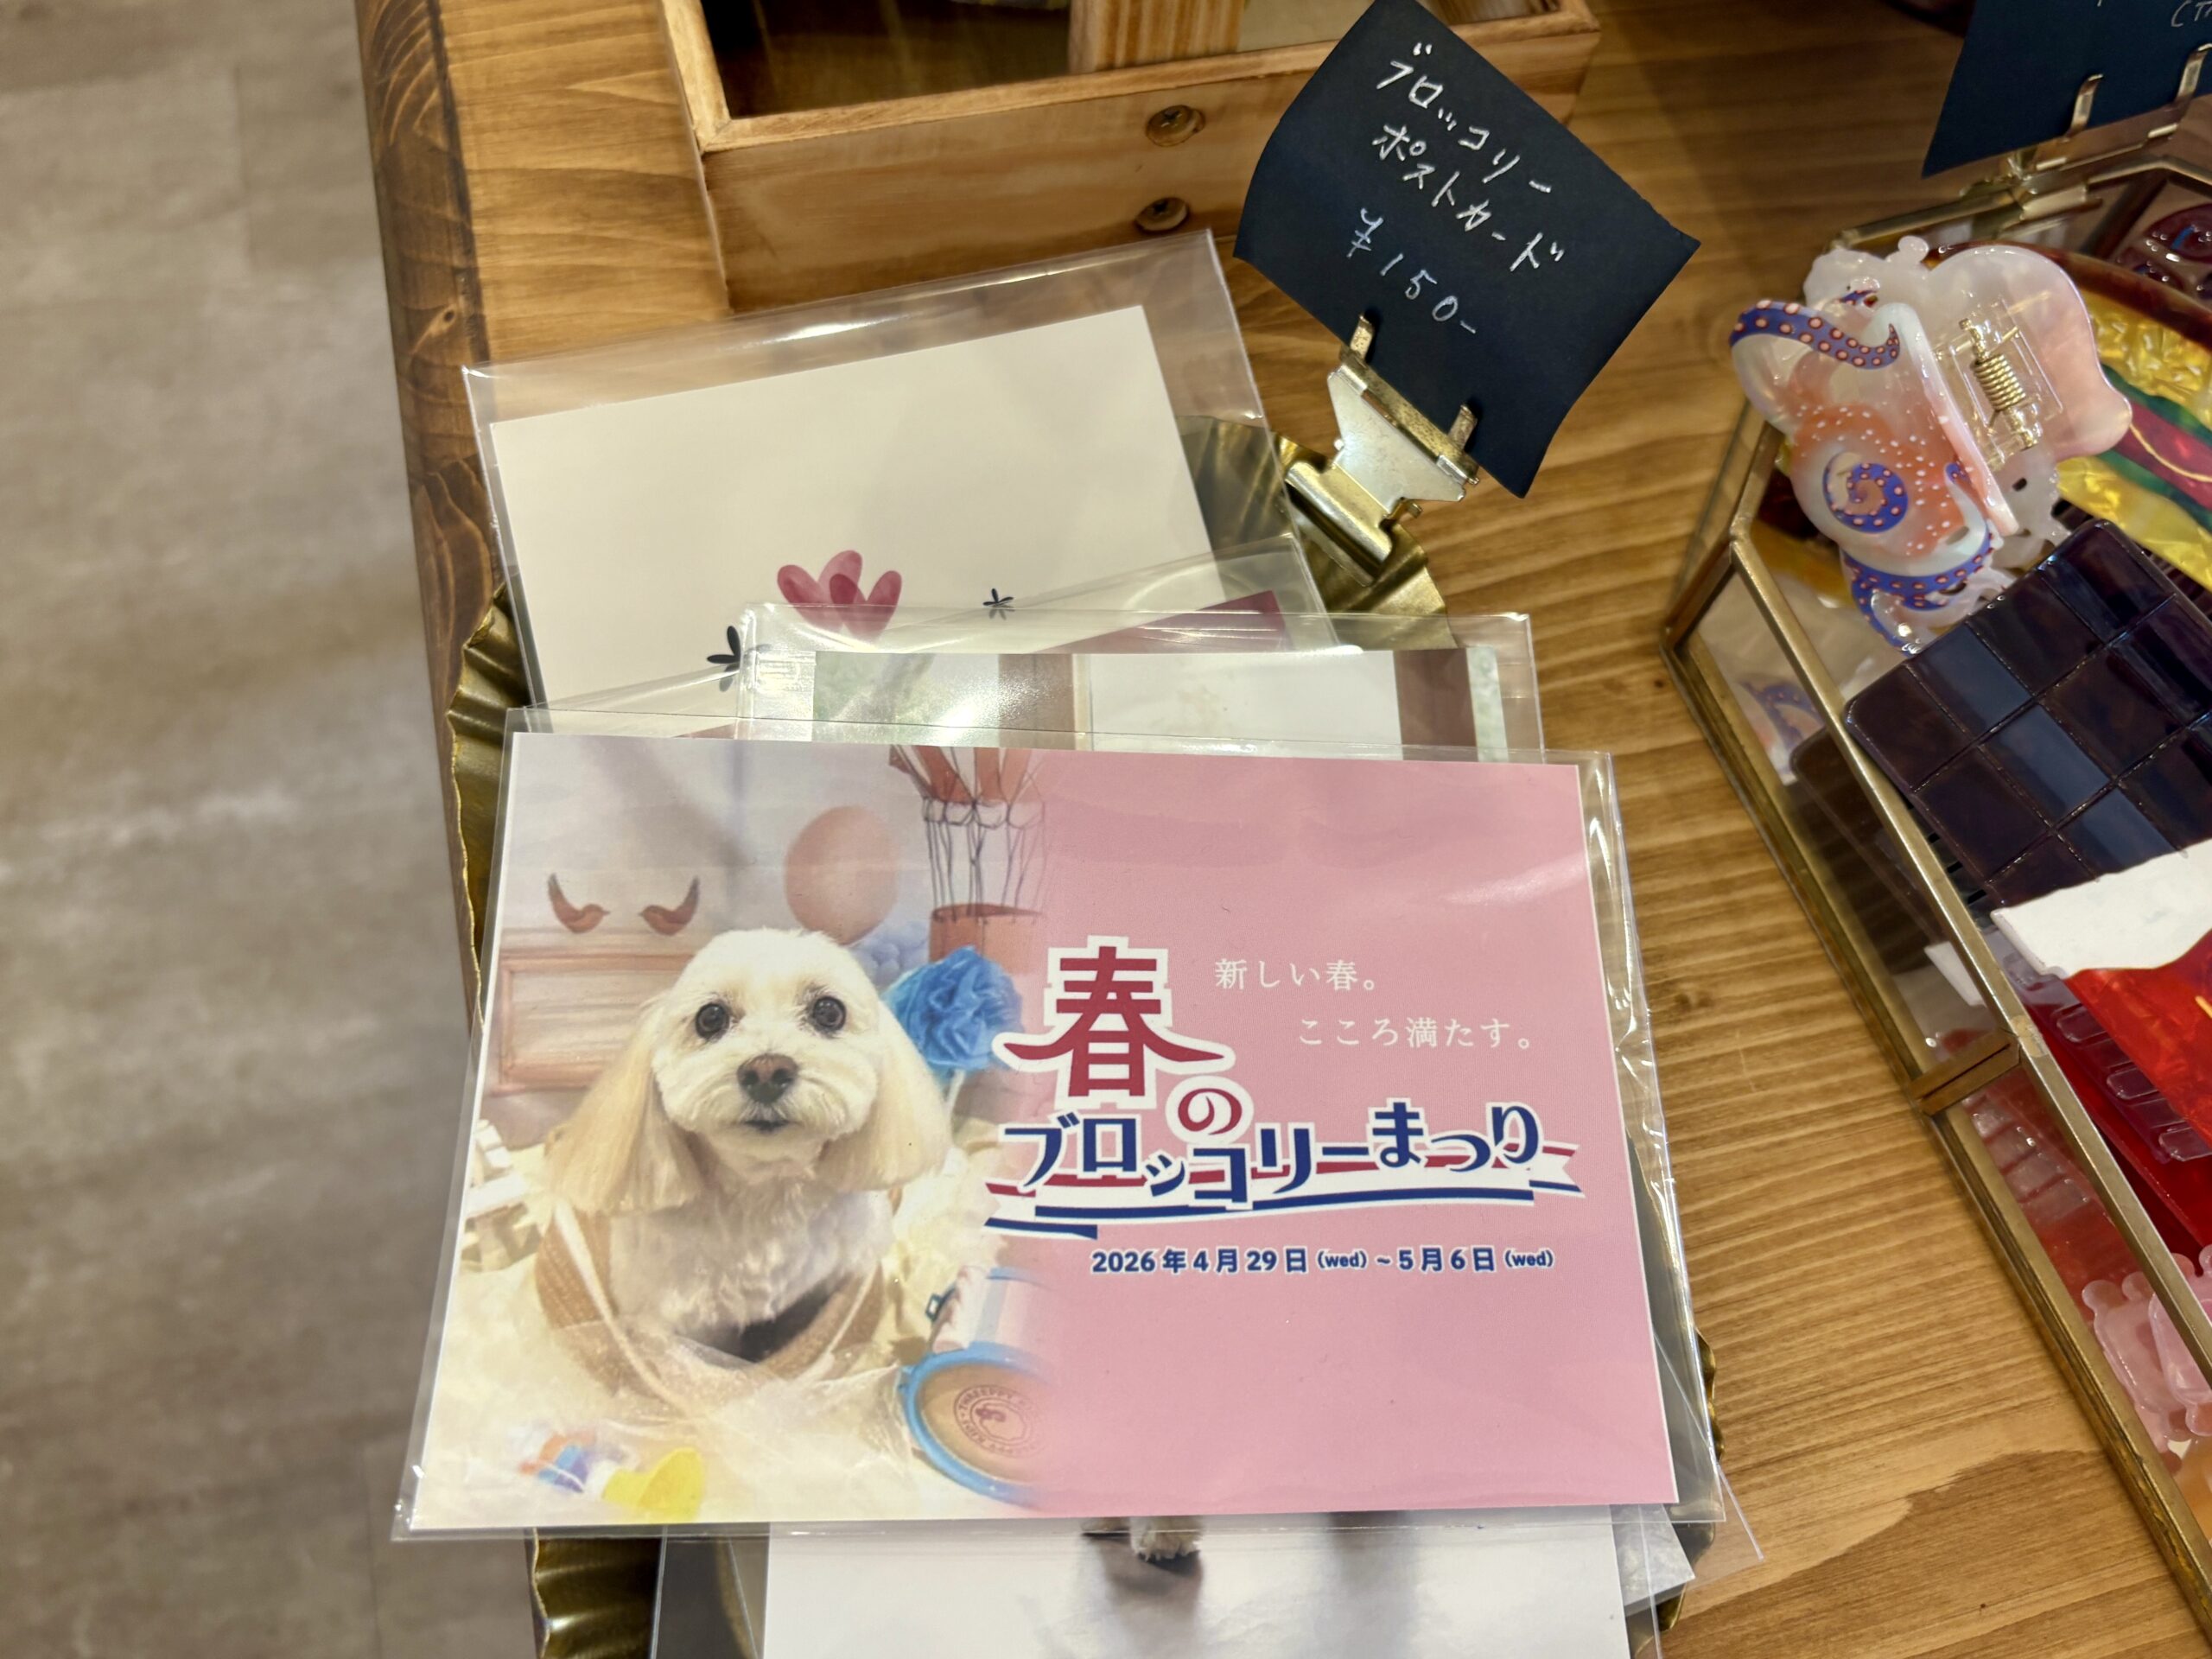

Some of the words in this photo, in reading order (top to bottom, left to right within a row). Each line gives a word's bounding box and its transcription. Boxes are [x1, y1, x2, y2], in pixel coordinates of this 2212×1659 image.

[1376, 42, 1552, 193] ブロッコリー
[1372, 124, 1565, 271] ポストカード
[1214, 958, 1375, 991] 新しい春。
[1299, 1017, 1530, 1050] こころ満たす。
[1002, 1099, 1541, 1205] ブロッコリーまつり
